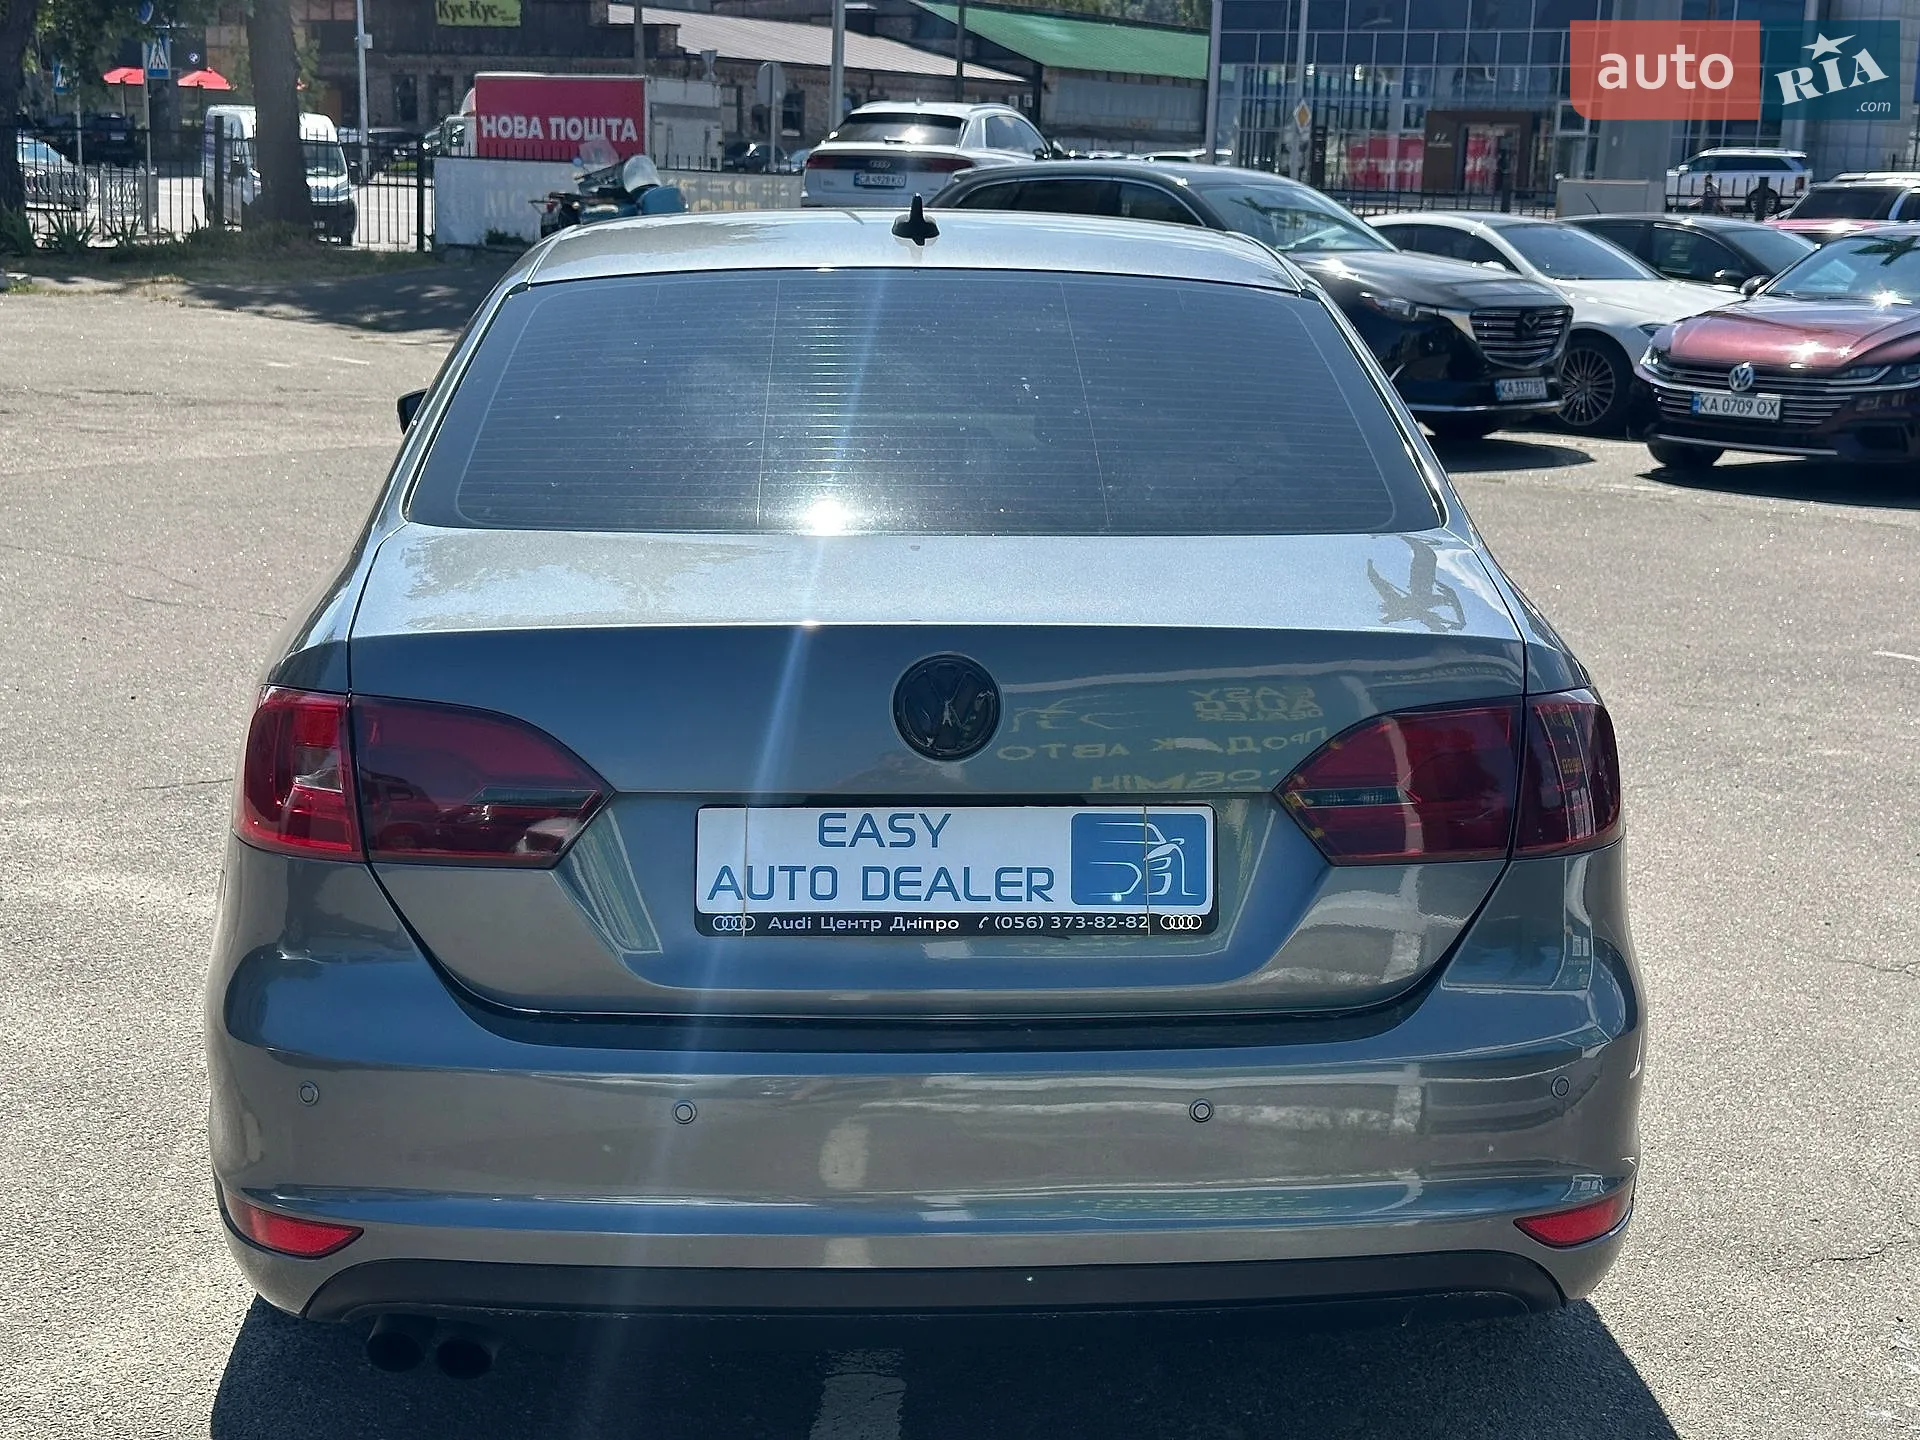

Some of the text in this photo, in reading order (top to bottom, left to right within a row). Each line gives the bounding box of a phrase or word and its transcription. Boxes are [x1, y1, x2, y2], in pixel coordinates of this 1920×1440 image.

[480, 115, 638, 142] НОВА ПОШТА
[1700, 397, 1778, 416] KA 0709 OX
[818, 812, 952, 848] EASY
[707, 865, 1055, 902] AUTO DEALER
[768, 915, 1149, 933] Audi Центр Дніпро (056) 373-82-82
